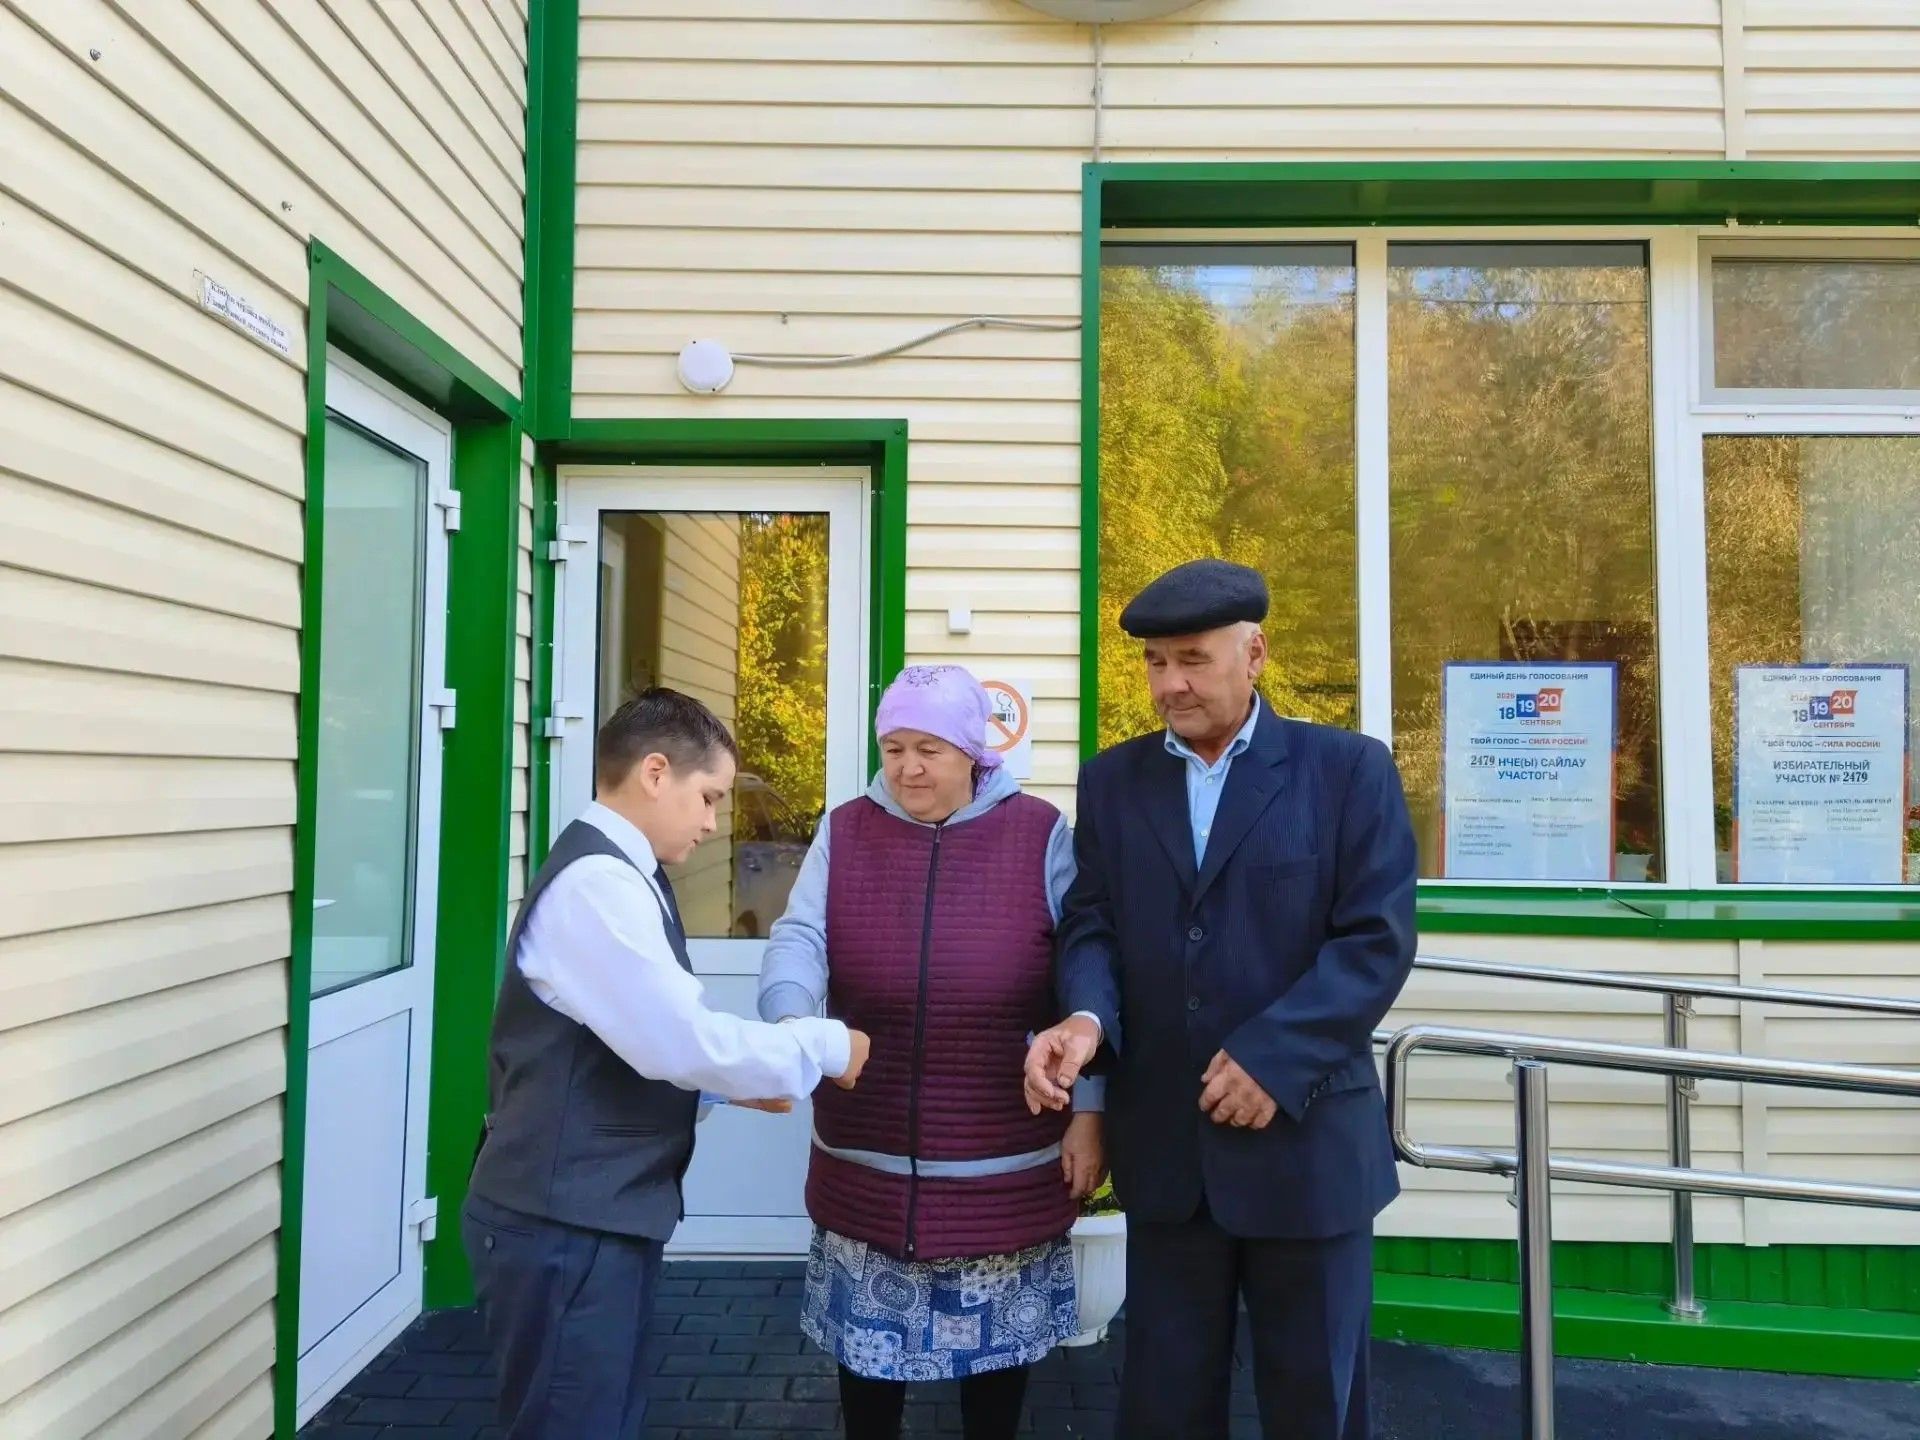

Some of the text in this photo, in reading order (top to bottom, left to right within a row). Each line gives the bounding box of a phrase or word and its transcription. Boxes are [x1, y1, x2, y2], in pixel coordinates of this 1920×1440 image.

[1470, 672, 1504, 680] ЕДИНЫЙ
[1499, 694, 1559, 719] 18 19 20
[1793, 696, 1852, 722] 18 19 20
[1470, 737, 1491, 745] ТВОЙ
[1470, 755, 1586, 768] 2479 НЧЕ(Ы) САЙЛАУ
[1773, 760, 1870, 770] ИЗБИРАТЕЛЬНЫЙ
[1498, 771, 1558, 780] УЧАСТОГЫ
[1776, 774, 1826, 783] УЧАСТОК
[1842, 772, 1869, 782] 2479
